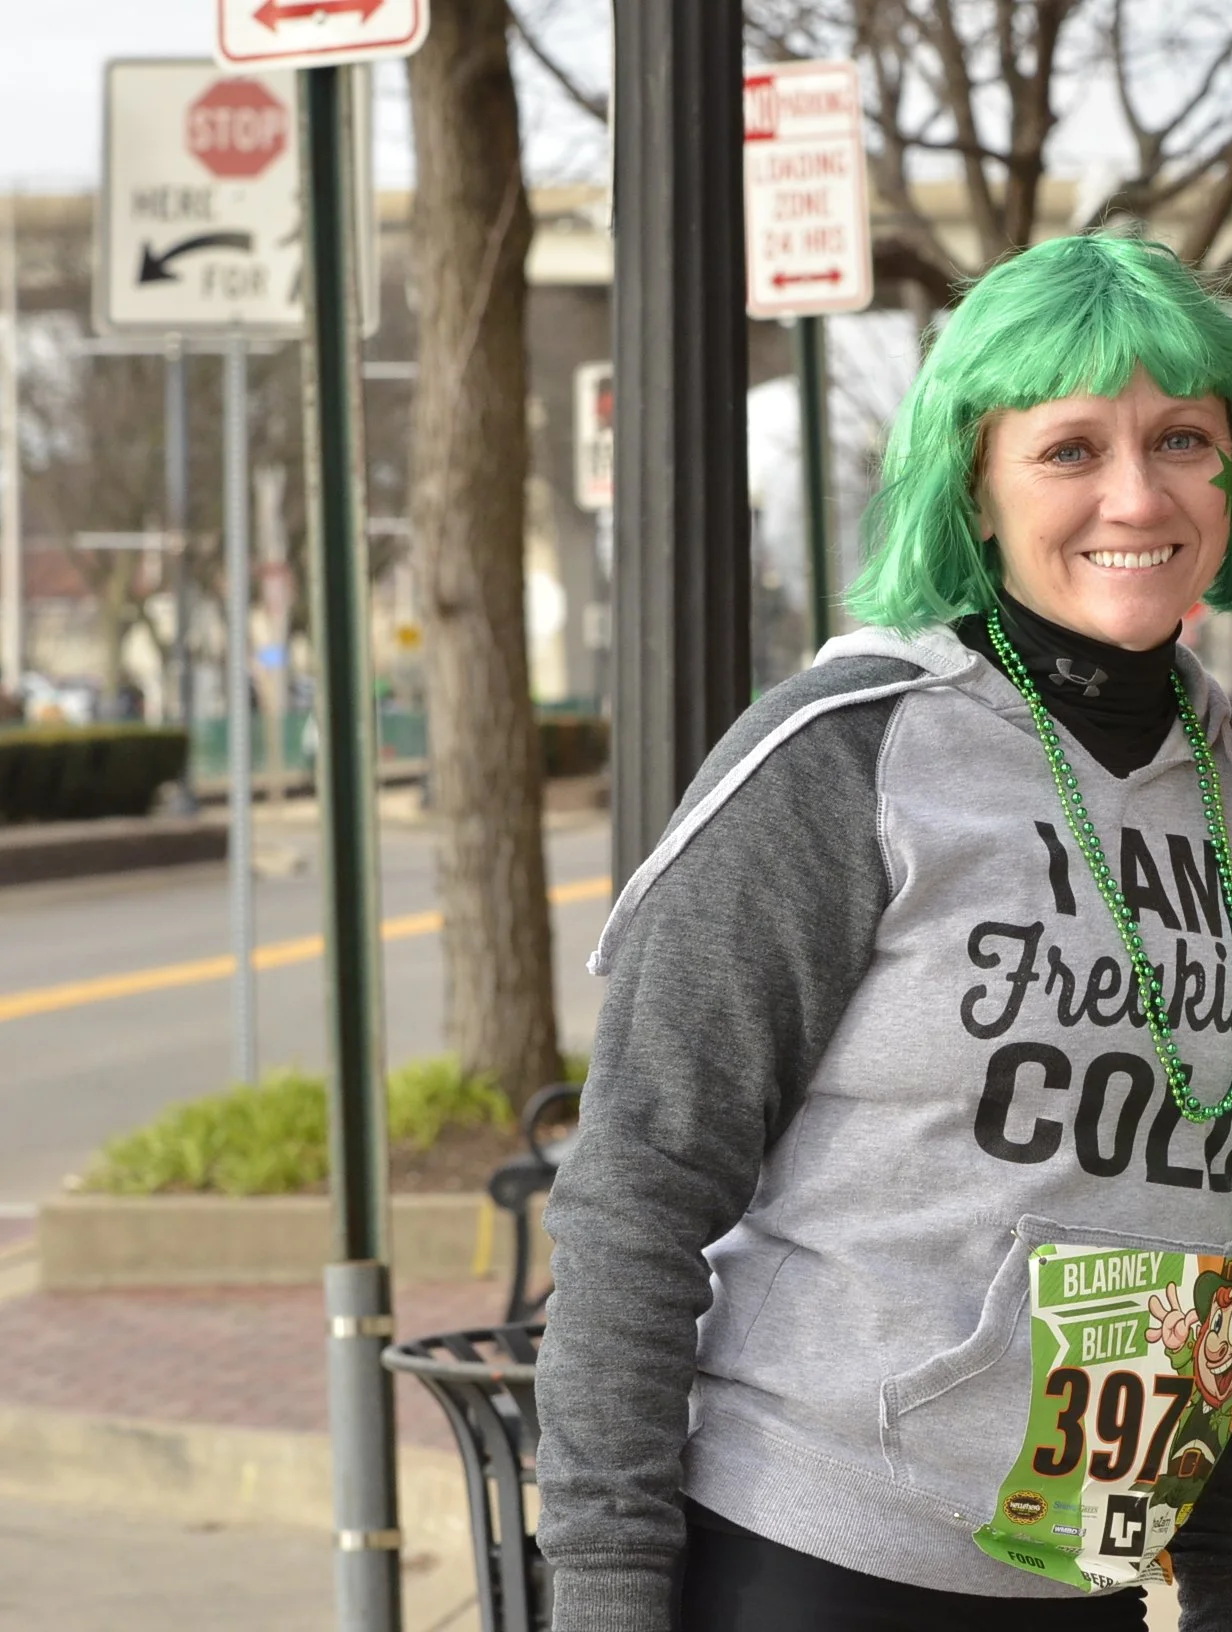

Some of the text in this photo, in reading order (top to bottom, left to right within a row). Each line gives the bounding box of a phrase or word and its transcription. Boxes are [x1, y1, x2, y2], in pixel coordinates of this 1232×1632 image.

[188, 105, 287, 151] STOP
[753, 149, 848, 183] LOADING
[130, 184, 214, 221] HERE
[773, 187, 830, 221] ZONE
[763, 223, 846, 261] 24 HRS
[200, 263, 267, 301] FOR
[1034, 820, 1077, 916] I
[1063, 1251, 1164, 1298] BLARNEY
[1082, 1319, 1139, 1362] BLITZ
[1032, 1366, 1195, 1484] 397
[1008, 1550, 1046, 1570] FOOD
